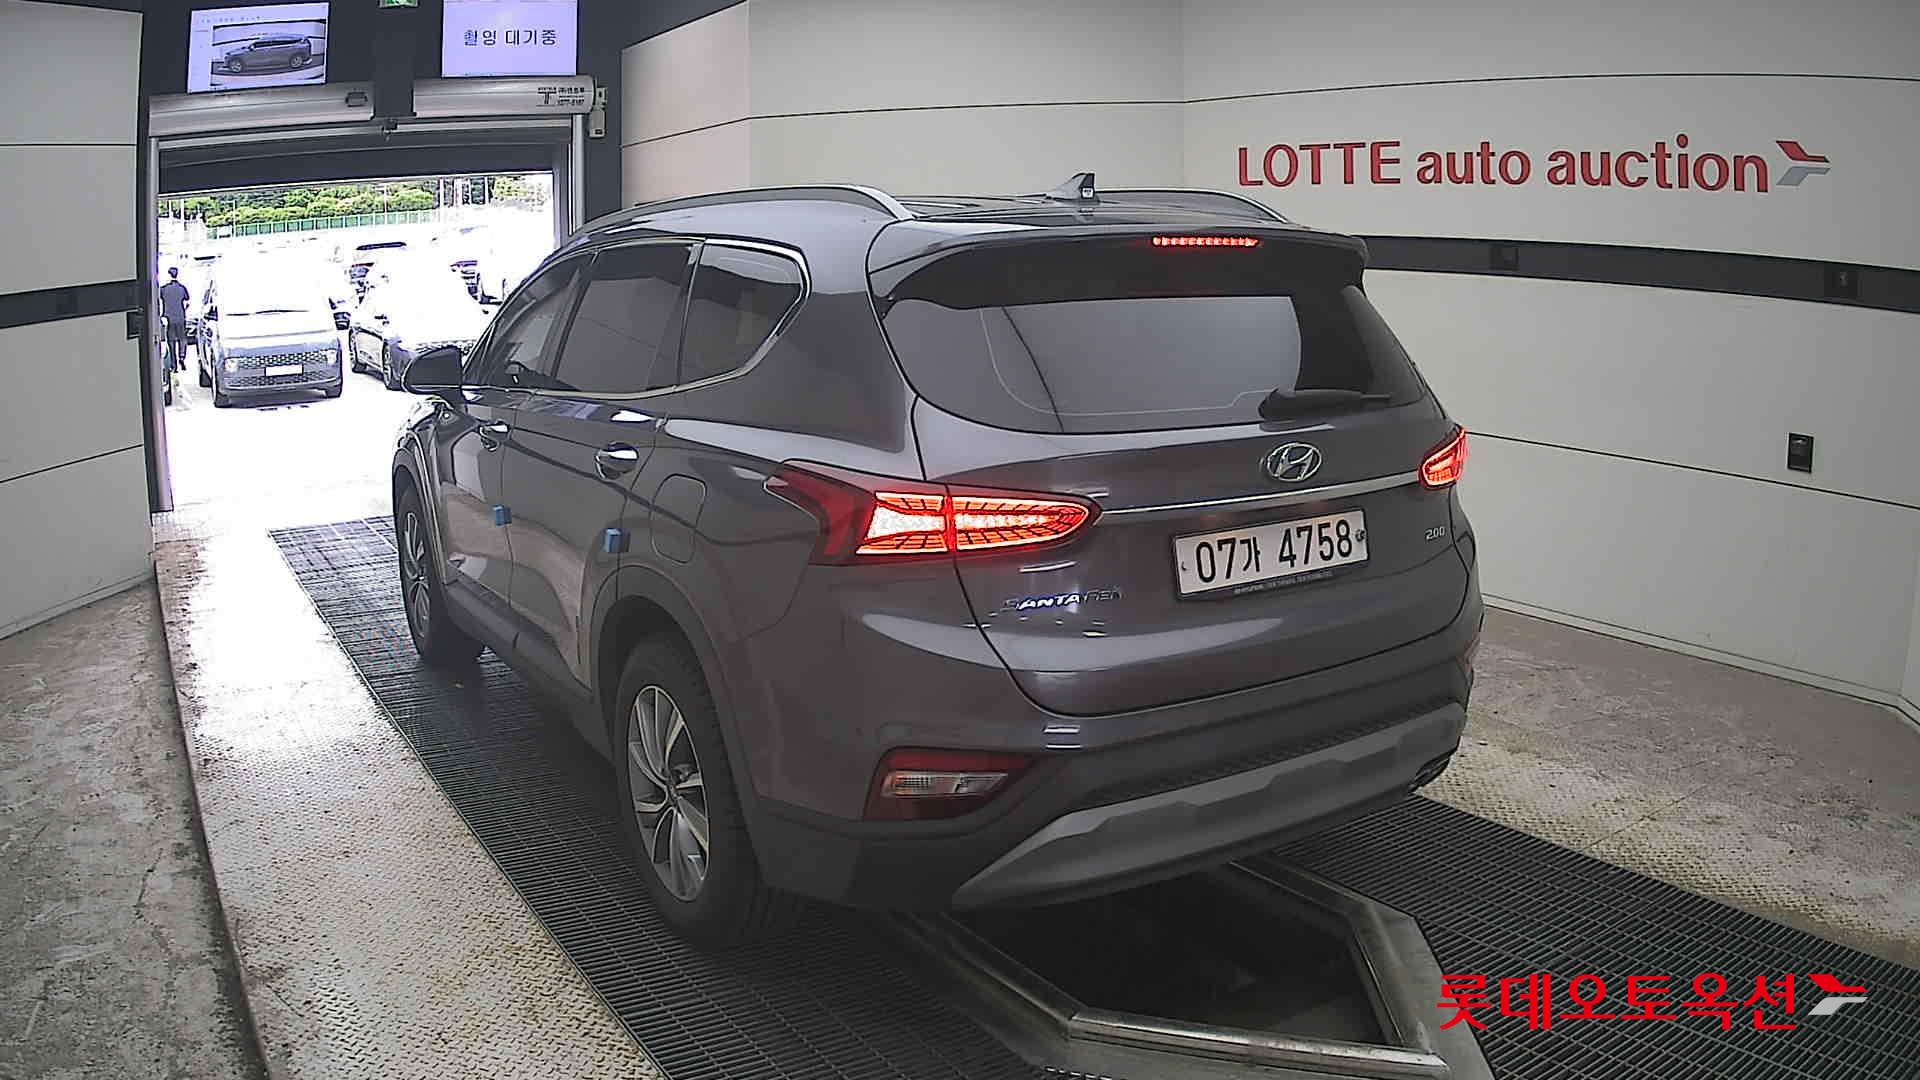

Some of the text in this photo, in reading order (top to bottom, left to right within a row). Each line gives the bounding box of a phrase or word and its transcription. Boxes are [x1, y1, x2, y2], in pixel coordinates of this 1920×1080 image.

[504, 29, 557, 46] 대기중
[1238, 133, 1769, 193] LOTTE auto auction
[1195, 536, 1261, 583] 07가
[1278, 518, 1353, 568] 4758
